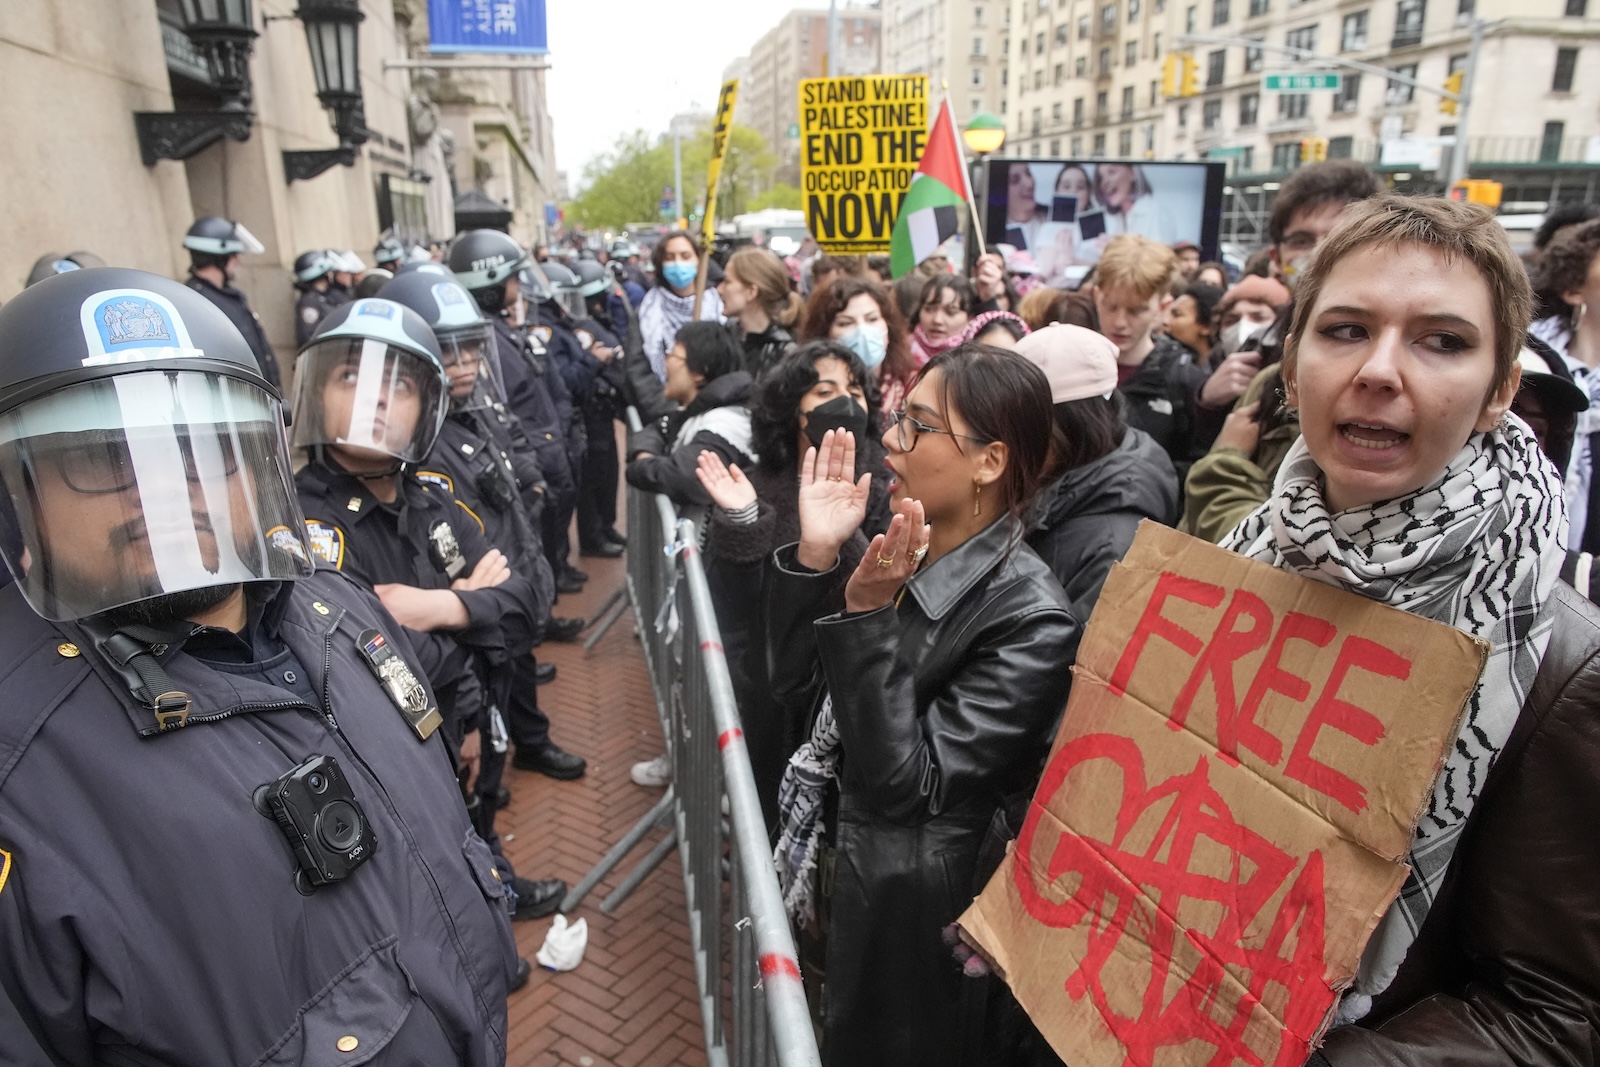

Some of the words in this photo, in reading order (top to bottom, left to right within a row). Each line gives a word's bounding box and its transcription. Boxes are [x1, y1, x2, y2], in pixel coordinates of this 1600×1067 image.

[804, 79, 866, 105] STAND
[873, 77, 924, 100] WITH
[805, 102, 924, 131] PALESTINE!
[807, 132, 863, 166] END
[872, 130, 926, 163] THE
[806, 168, 915, 192] OCCUPATIO
[808, 192, 908, 238] NOW
[312, 601, 330, 615] 6
[1106, 570, 1412, 815] FREE
[348, 844, 365, 861] AXON
